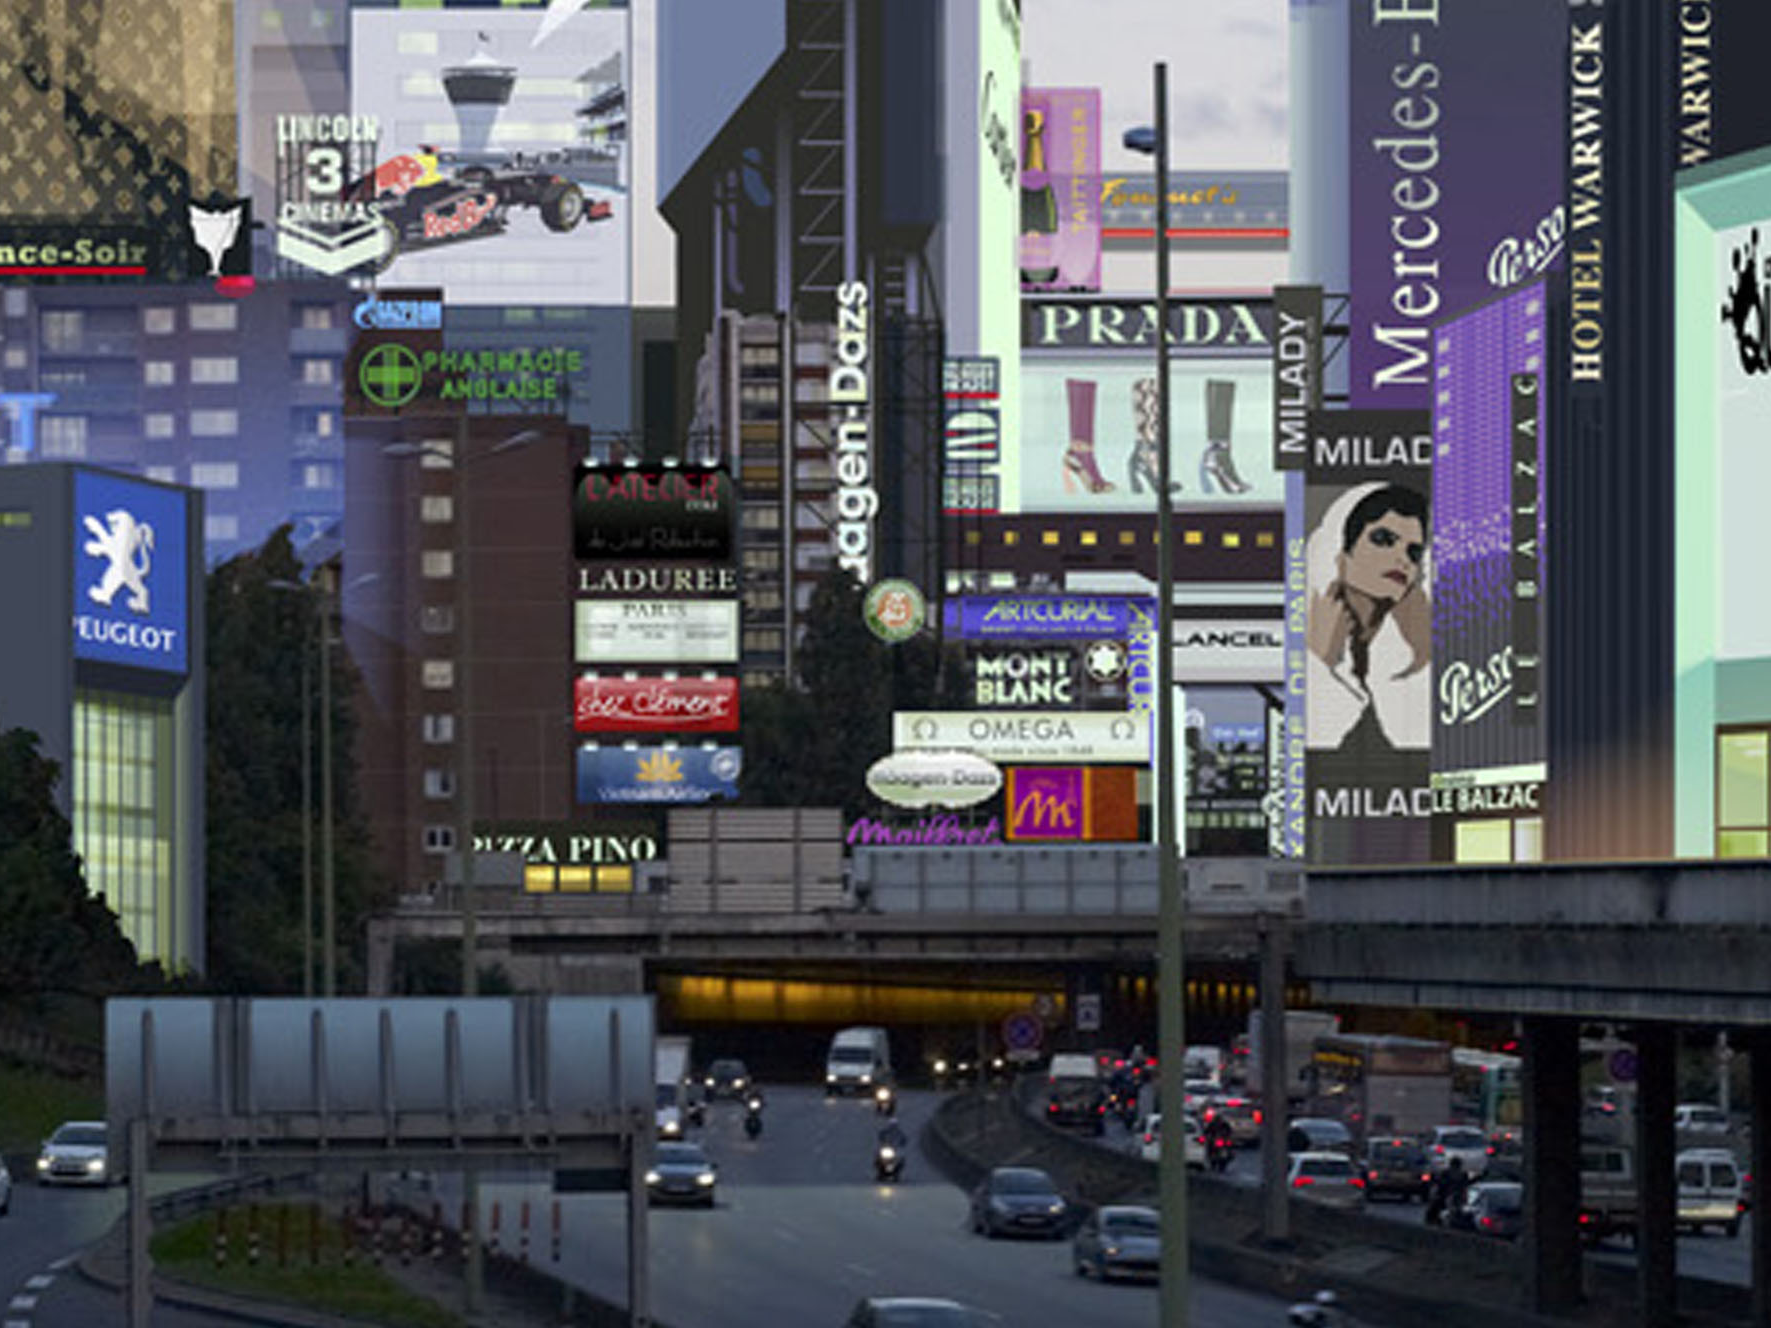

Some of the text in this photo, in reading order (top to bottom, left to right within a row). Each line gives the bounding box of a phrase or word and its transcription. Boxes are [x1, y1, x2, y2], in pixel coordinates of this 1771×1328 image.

[277, 113, 380, 144] LINCOLN
[305, 147, 344, 195] 3
[1571, 22, 1603, 381] HOTEL WARWICK
[1038, 304, 1269, 345] PRADA
[422, 349, 583, 372] PHARMACIE
[1280, 312, 1307, 455] MILADY
[977, 653, 1070, 678] MONT
[977, 677, 1073, 704] BLANC
[968, 718, 1075, 741] OMEGA
[1432, 783, 1540, 813] LE BALZAC
[568, 835, 658, 862] PINO
